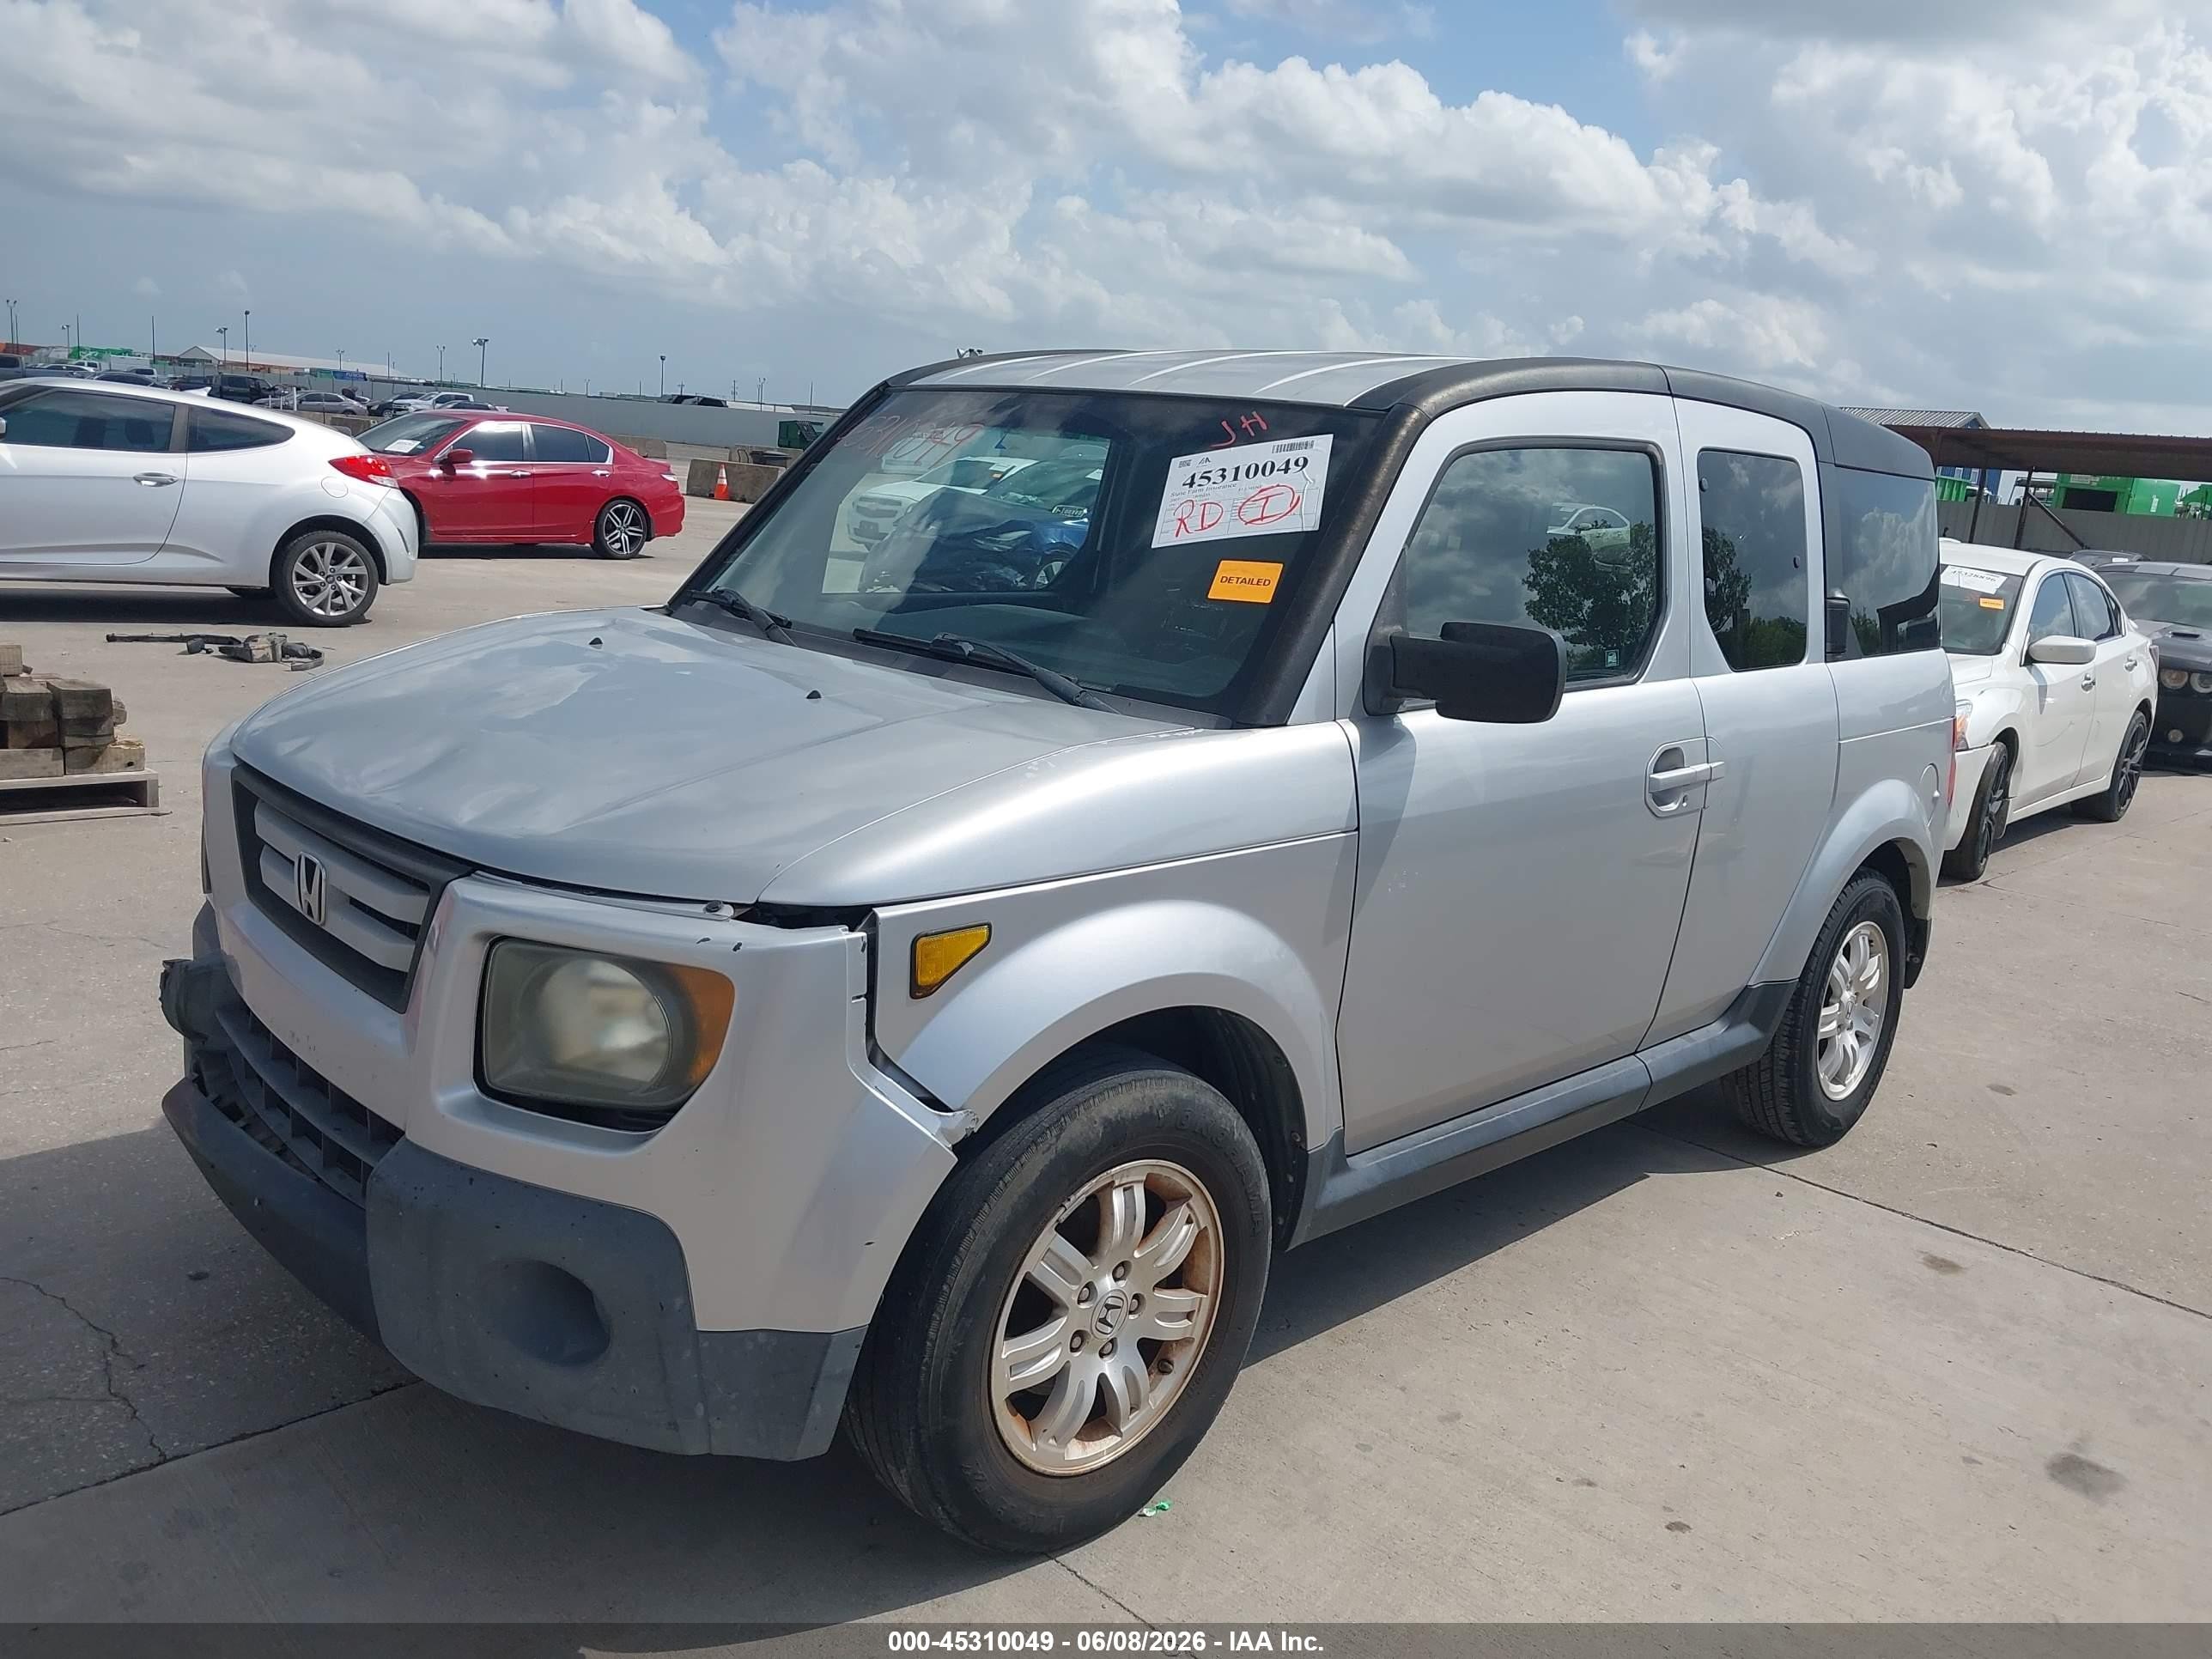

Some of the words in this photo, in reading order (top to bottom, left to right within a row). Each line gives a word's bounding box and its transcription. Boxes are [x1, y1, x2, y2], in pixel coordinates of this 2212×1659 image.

[1182, 456, 1309, 489] 45310049
[1173, 500, 1224, 537] RD
[1219, 575, 1271, 586] DETAILED
